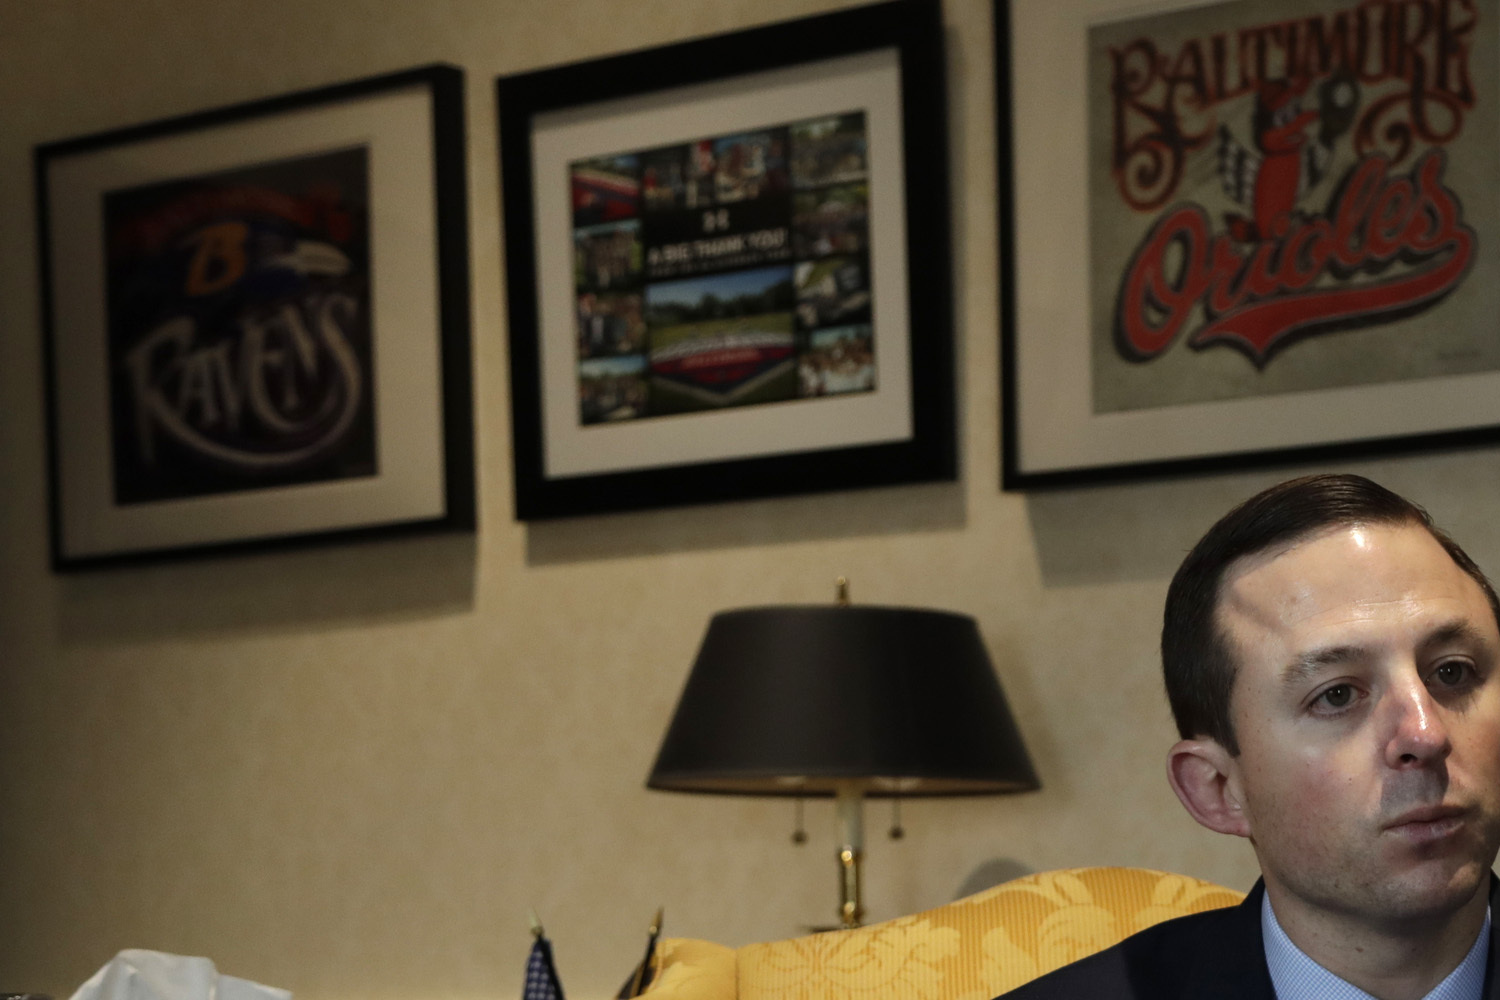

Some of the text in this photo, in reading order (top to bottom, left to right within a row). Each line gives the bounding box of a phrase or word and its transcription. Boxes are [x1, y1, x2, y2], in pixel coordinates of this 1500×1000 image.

[692, 234, 745, 258] THANK
[1115, 148, 1476, 365] Orioles
[124, 291, 363, 470] RAVENS
